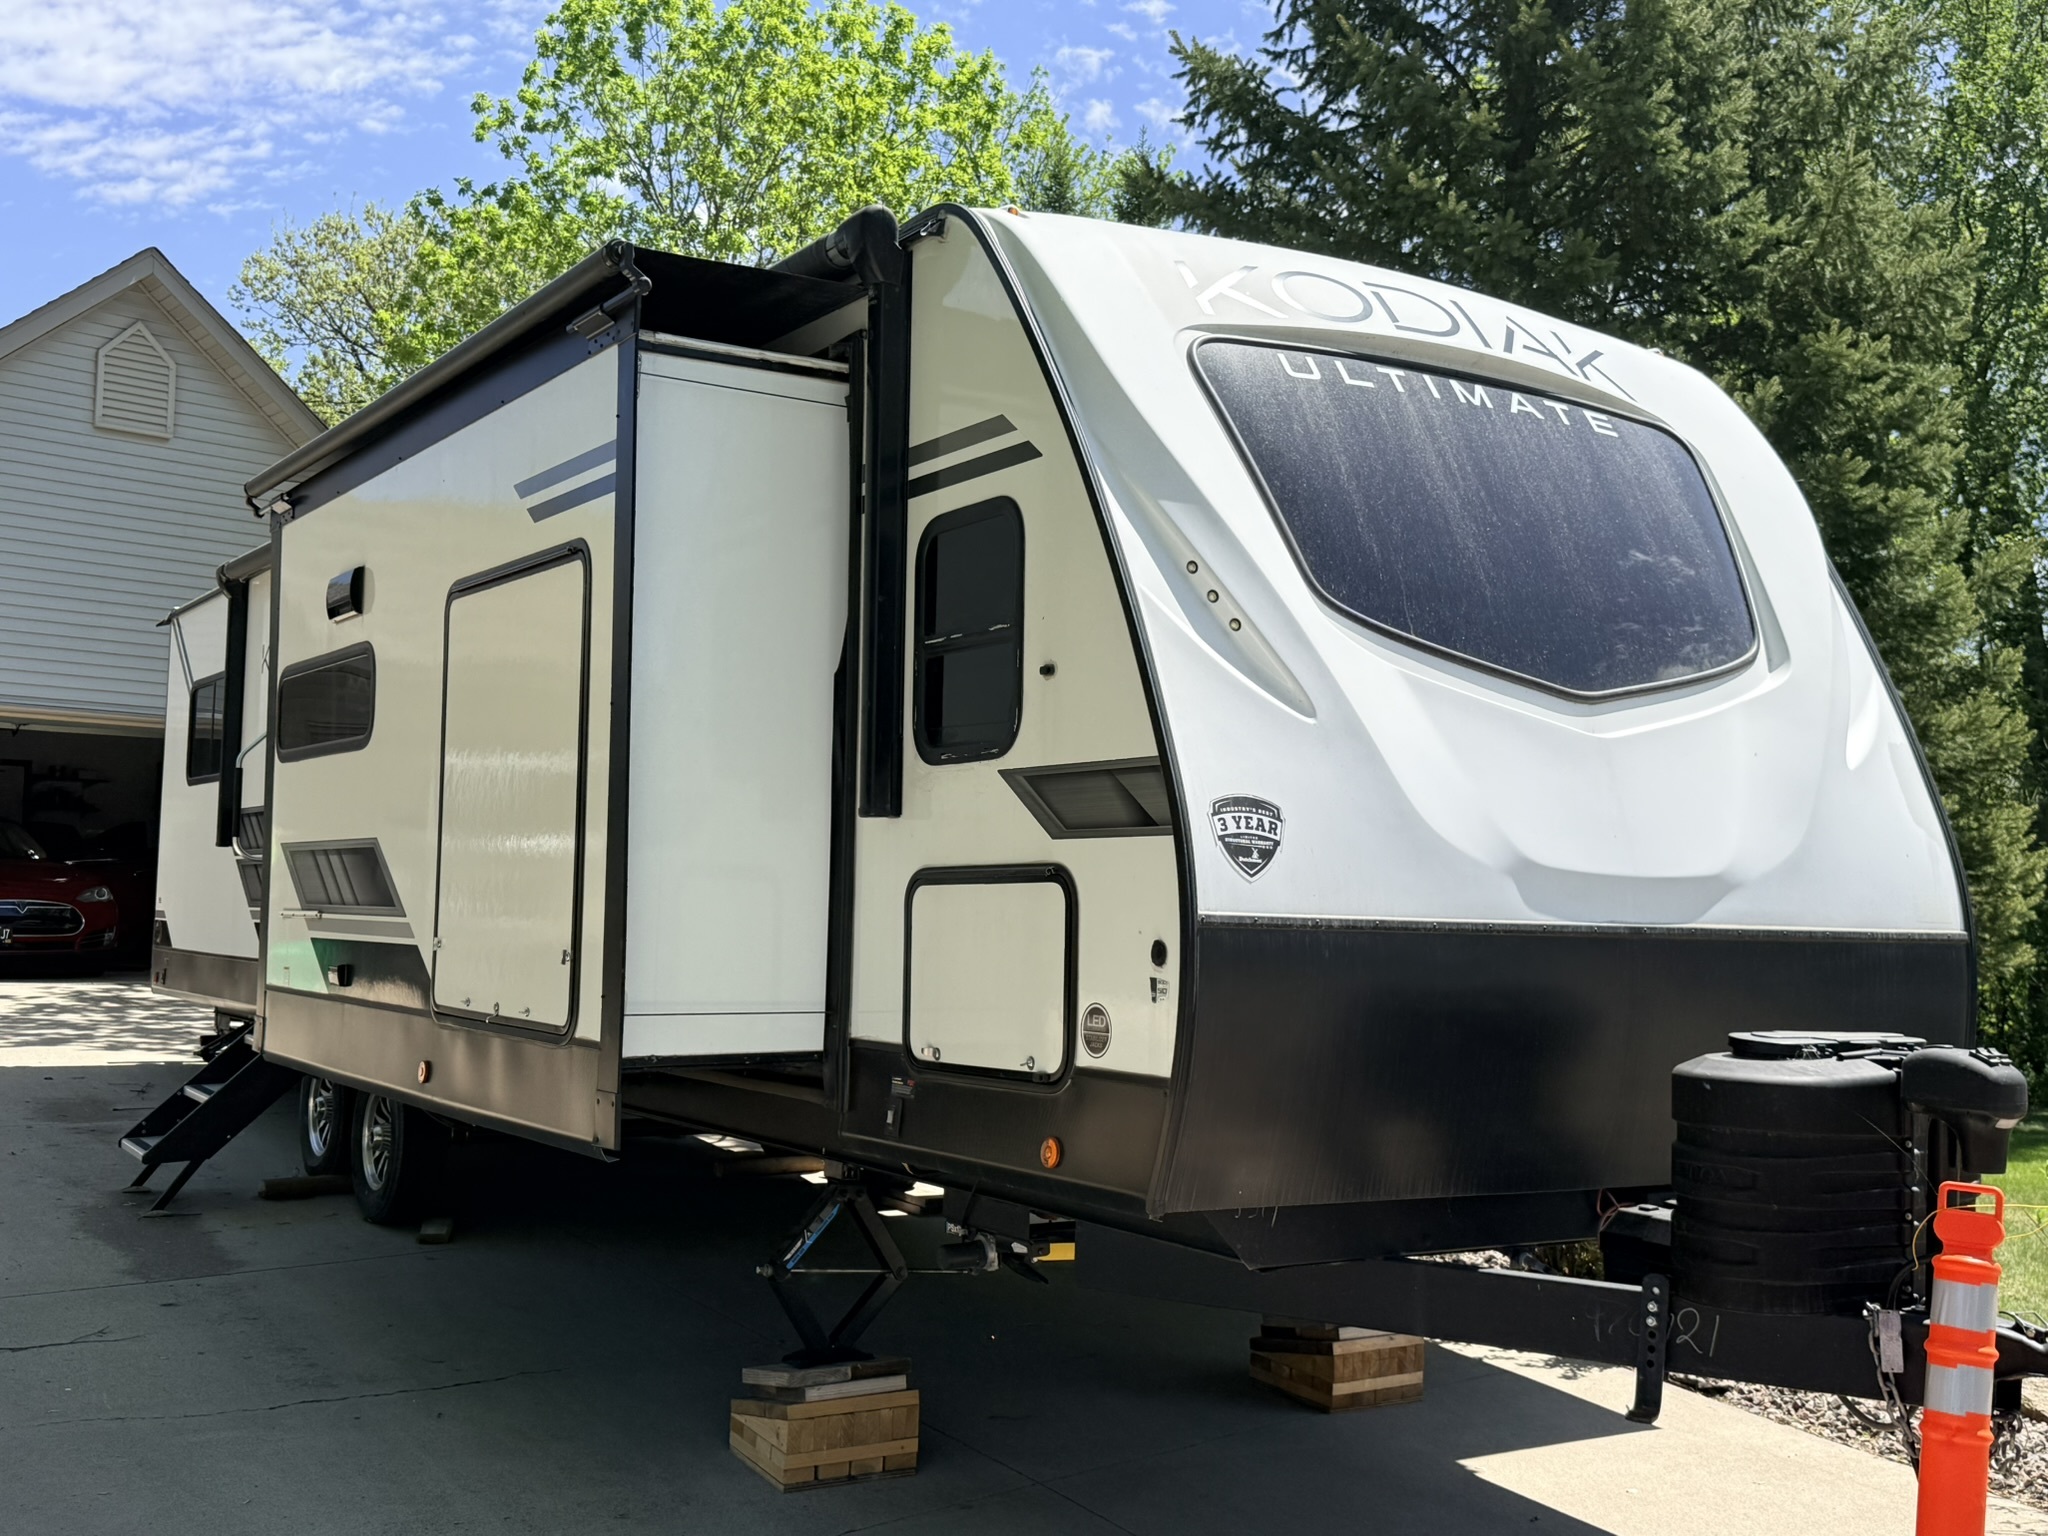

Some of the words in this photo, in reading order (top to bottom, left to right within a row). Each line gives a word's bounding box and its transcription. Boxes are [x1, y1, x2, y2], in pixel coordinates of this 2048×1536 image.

[1173, 259, 1638, 403] KODIAK
[1277, 352, 1619, 438] ULTIMATE
[1217, 817, 1229, 832] 3
[1231, 815, 1279, 837] YEAR
[1086, 1013, 1107, 1028] LED
[1667, 1307, 1720, 1357] 21
